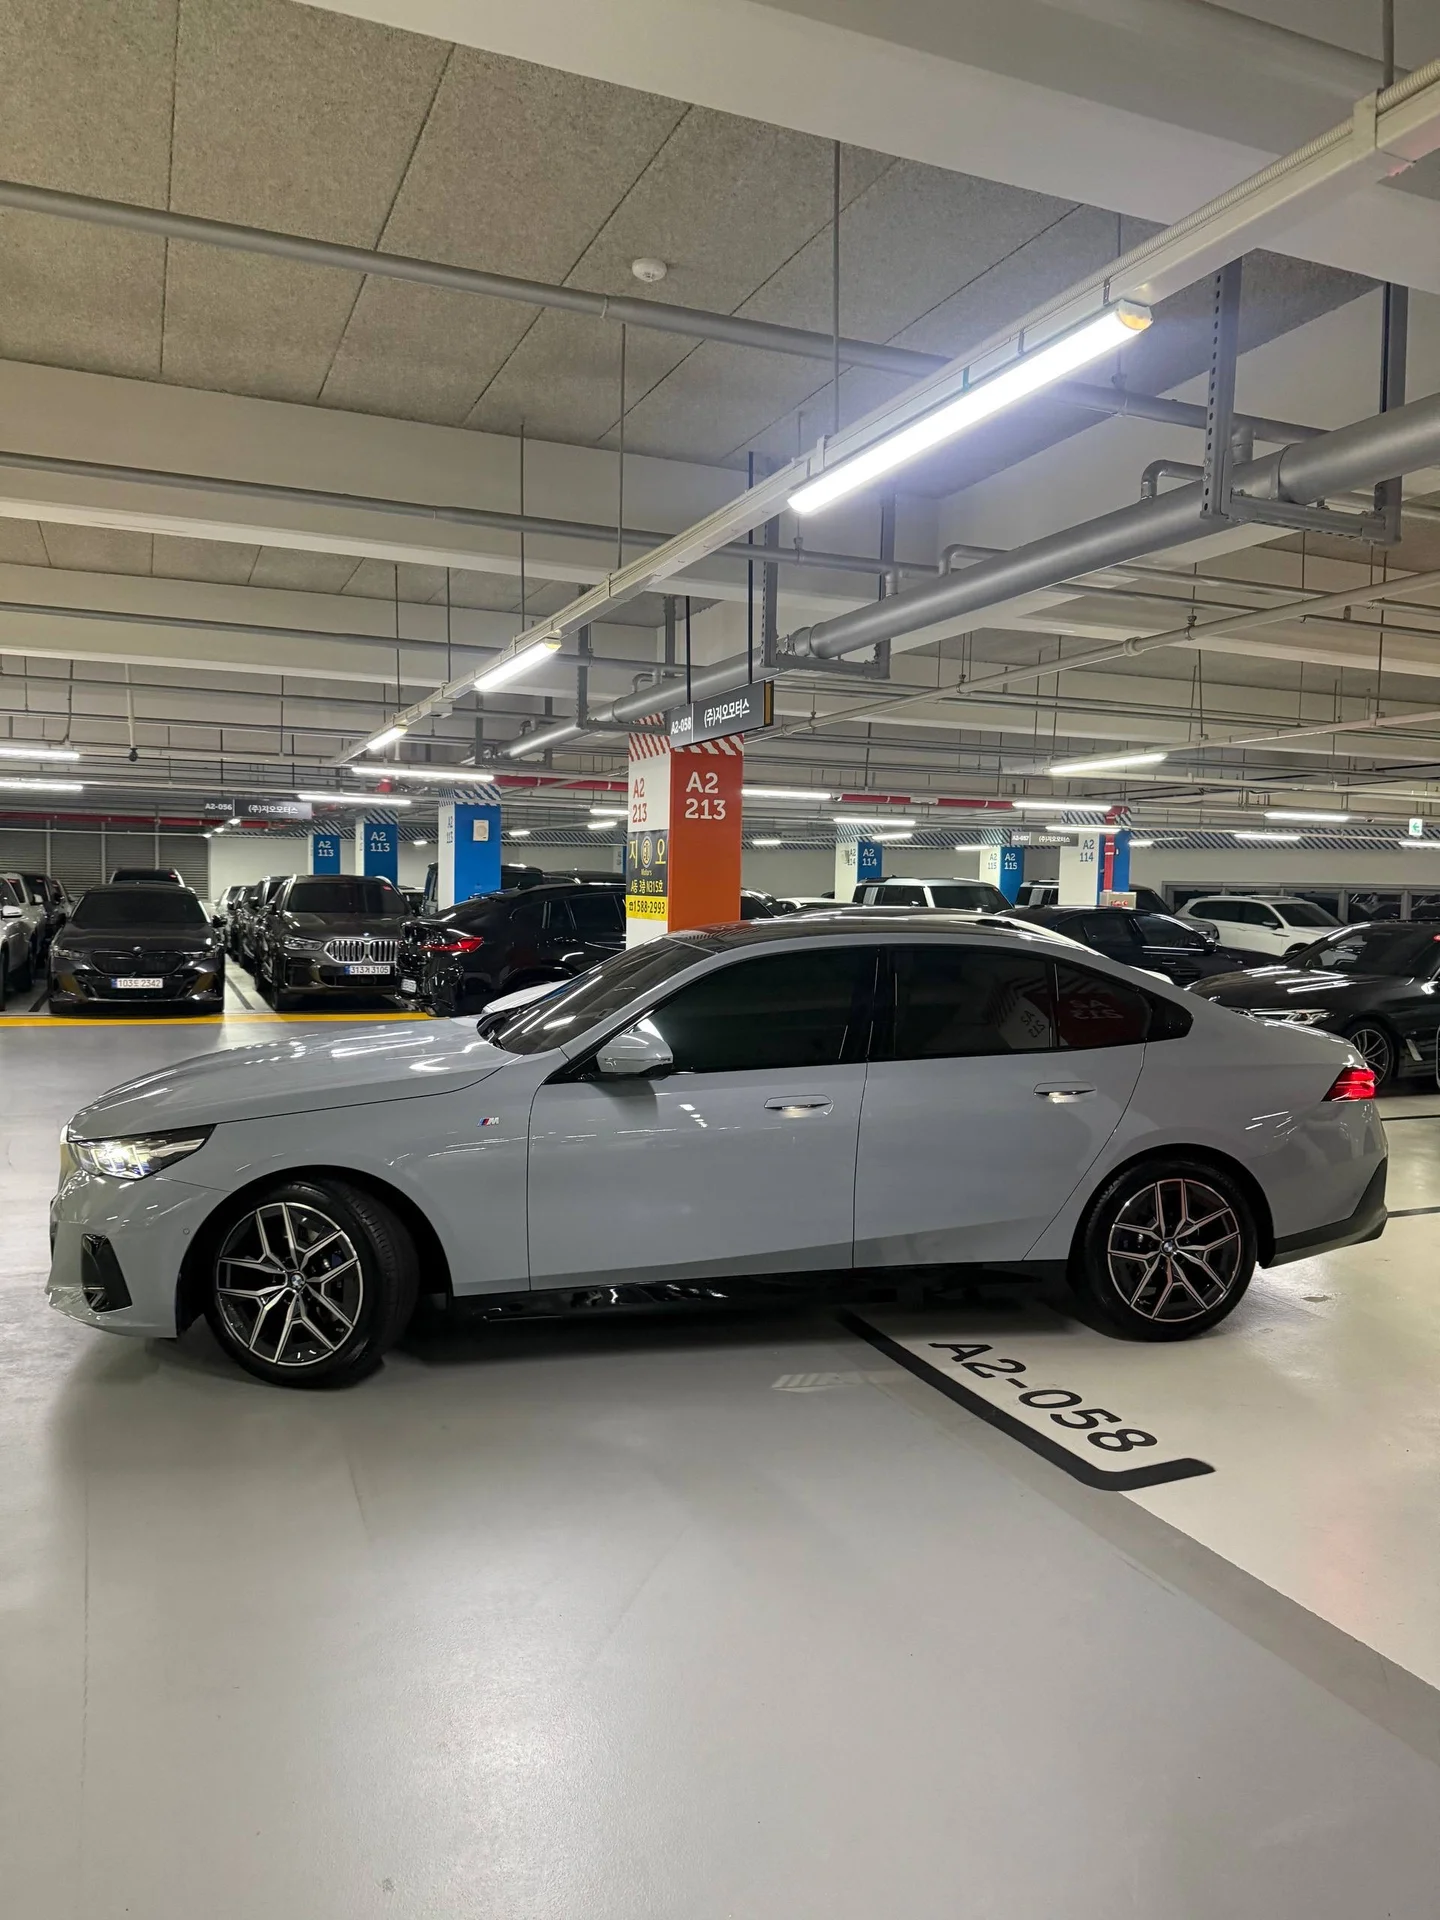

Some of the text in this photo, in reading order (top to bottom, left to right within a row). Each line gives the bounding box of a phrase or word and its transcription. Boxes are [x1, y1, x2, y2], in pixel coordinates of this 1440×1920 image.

[703, 697, 751, 729] (주)지오모터스
[671, 716, 692, 736] A2-058
[632, 777, 645, 799] A2
[685, 771, 719, 794] A2
[204, 803, 233, 812] A2-056
[248, 804, 299, 815] (주)지오모터스
[632, 802, 648, 824] 213
[685, 798, 727, 820] 213
[370, 831, 387, 842] A2
[318, 840, 332, 849] A2
[370, 842, 391, 853] 113
[1082, 839, 1095, 850] A2
[317, 849, 335, 857] 113
[628, 839, 639, 869] 지
[654, 838, 667, 865] 오
[862, 848, 876, 857] A2
[989, 853, 998, 861] A2
[1004, 852, 1017, 861] A2
[1079, 852, 1095, 863] 114
[862, 857, 878, 866] 114
[1004, 862, 1018, 870] 115
[927, 1342, 1158, 1452] A2-058
